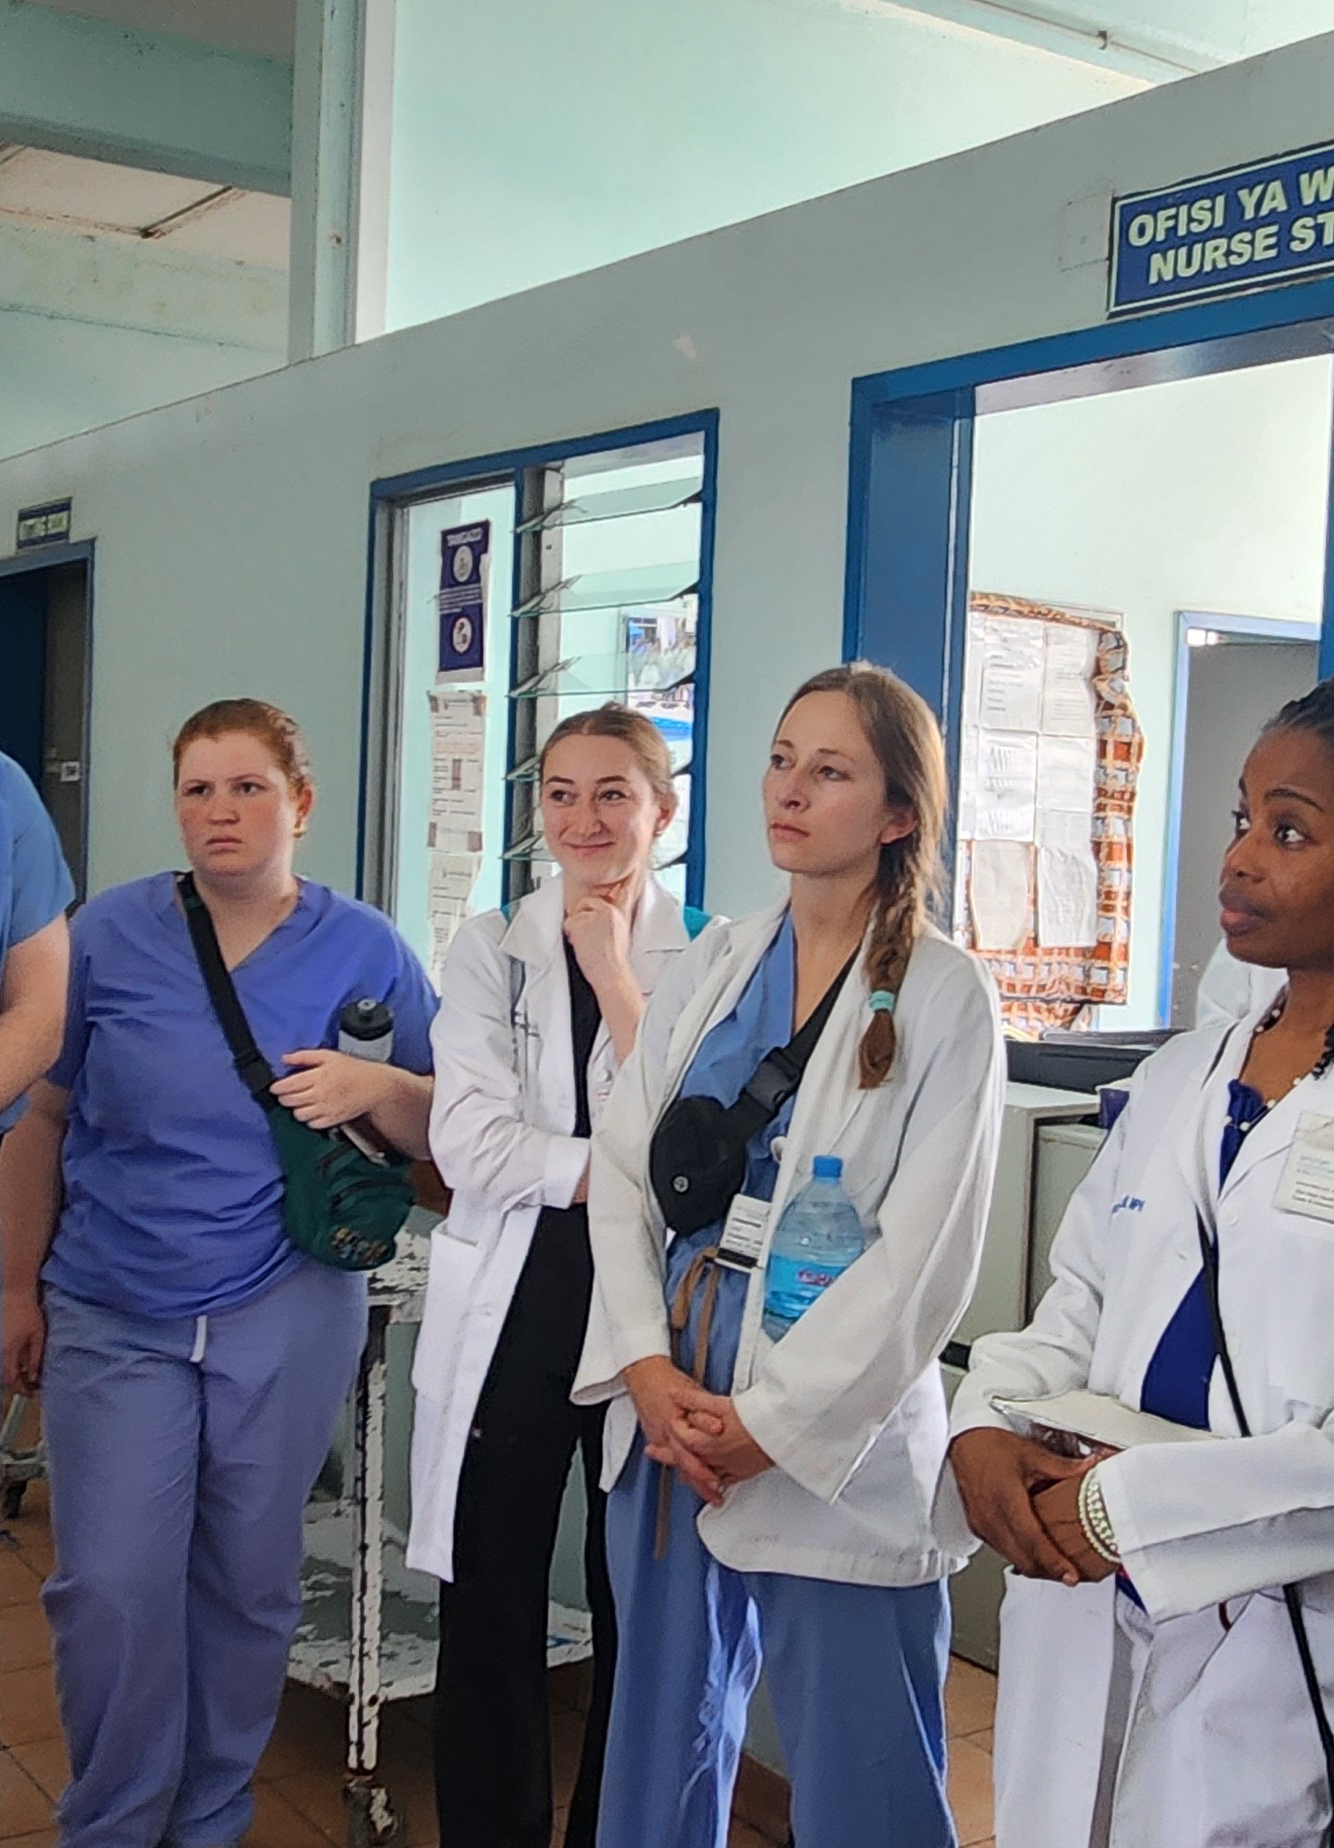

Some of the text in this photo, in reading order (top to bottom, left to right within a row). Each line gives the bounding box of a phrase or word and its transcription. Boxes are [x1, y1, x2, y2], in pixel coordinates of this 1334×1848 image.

[1128, 193, 1225, 247] OFISI
[1238, 180, 1288, 221] YA
[1148, 224, 1280, 285] NURSE
